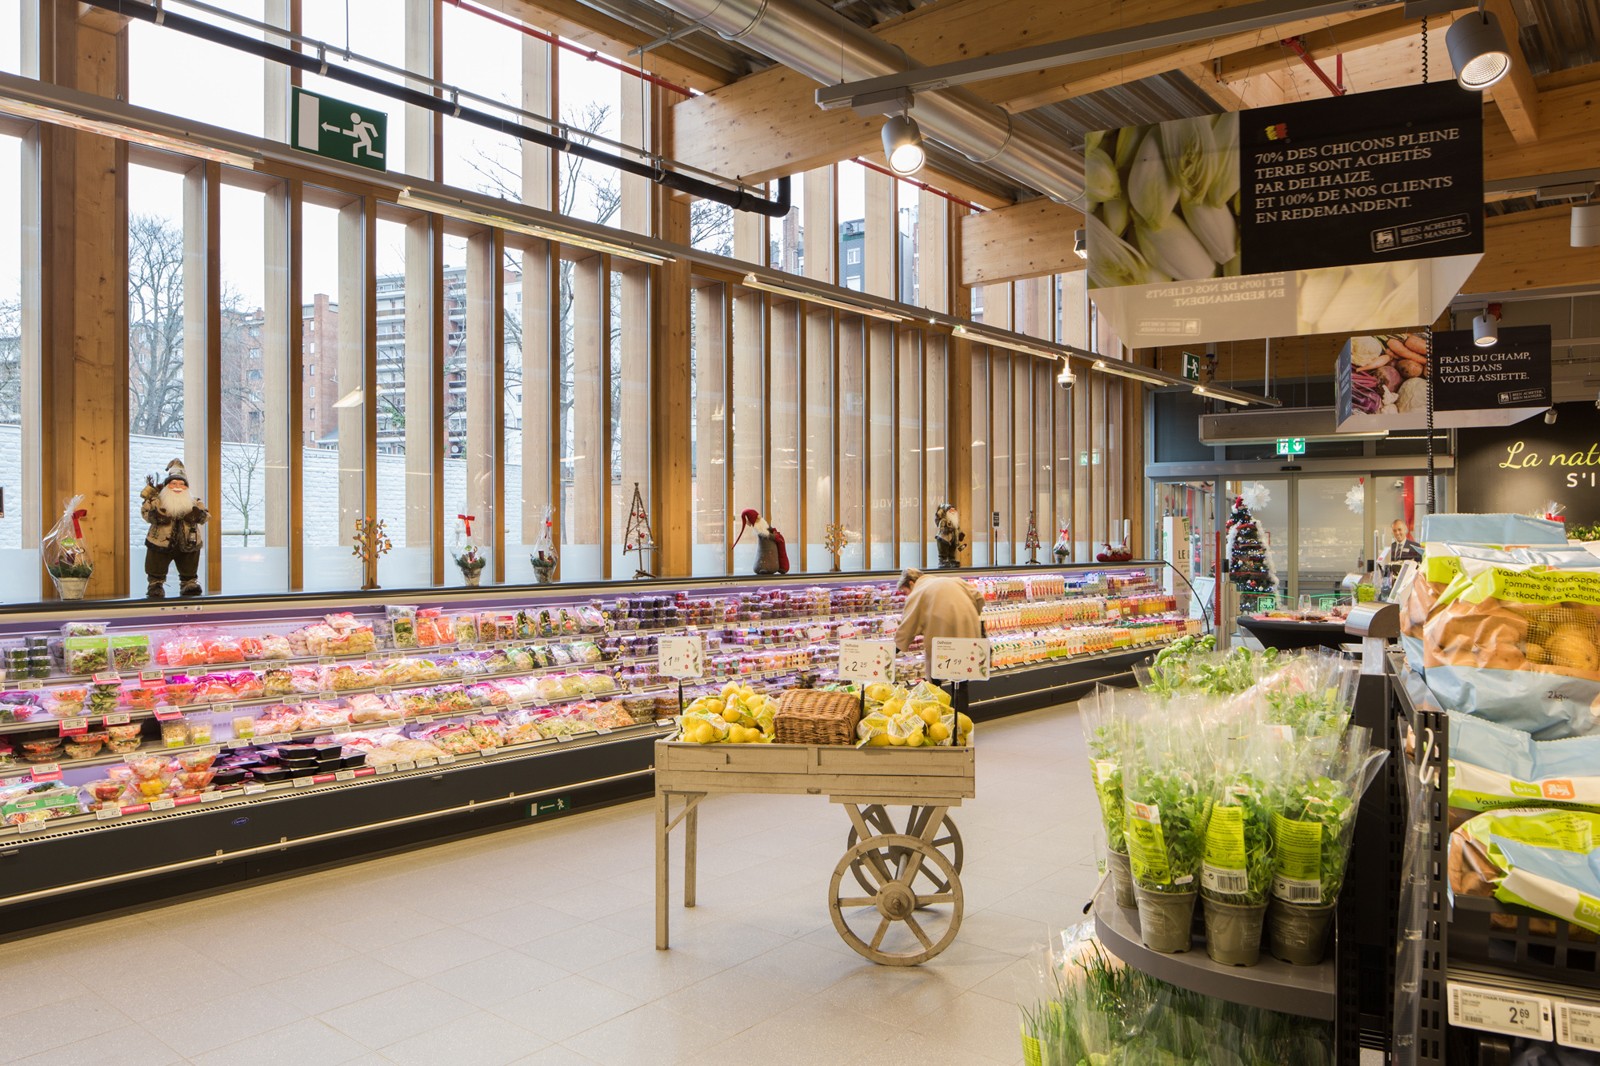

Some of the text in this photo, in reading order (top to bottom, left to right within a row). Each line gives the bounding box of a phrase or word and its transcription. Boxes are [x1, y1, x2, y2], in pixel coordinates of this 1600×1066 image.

[1255, 128, 1460, 164] 70% DES CHICONS PLEINE
[1255, 146, 1432, 180] TERRE SONT ACHETÉS
[1255, 171, 1374, 194] PAR DELHAIZE.
[1256, 176, 1453, 209] ET 100% DE NOS CLIENTS
[1256, 197, 1412, 224] EN REDEMANDENT.
[1440, 355, 1470, 364] FRAIS
[1490, 352, 1531, 361] CHAMP,
[1440, 364, 1502, 374] FRAIS DANS
[1440, 372, 1530, 384] VOTRE ASSIETTE.
[1499, 440, 1542, 469] La
[1178, 550, 1186, 559] LE
[1505, 579, 1540, 590] Pommes
[1503, 588, 1561, 601] Festkochende
[852, 661, 857, 671] 2
[945, 659, 951, 668] 1
[1514, 786, 1536, 794] bio
[1509, 1007, 1529, 1024] 2 69
